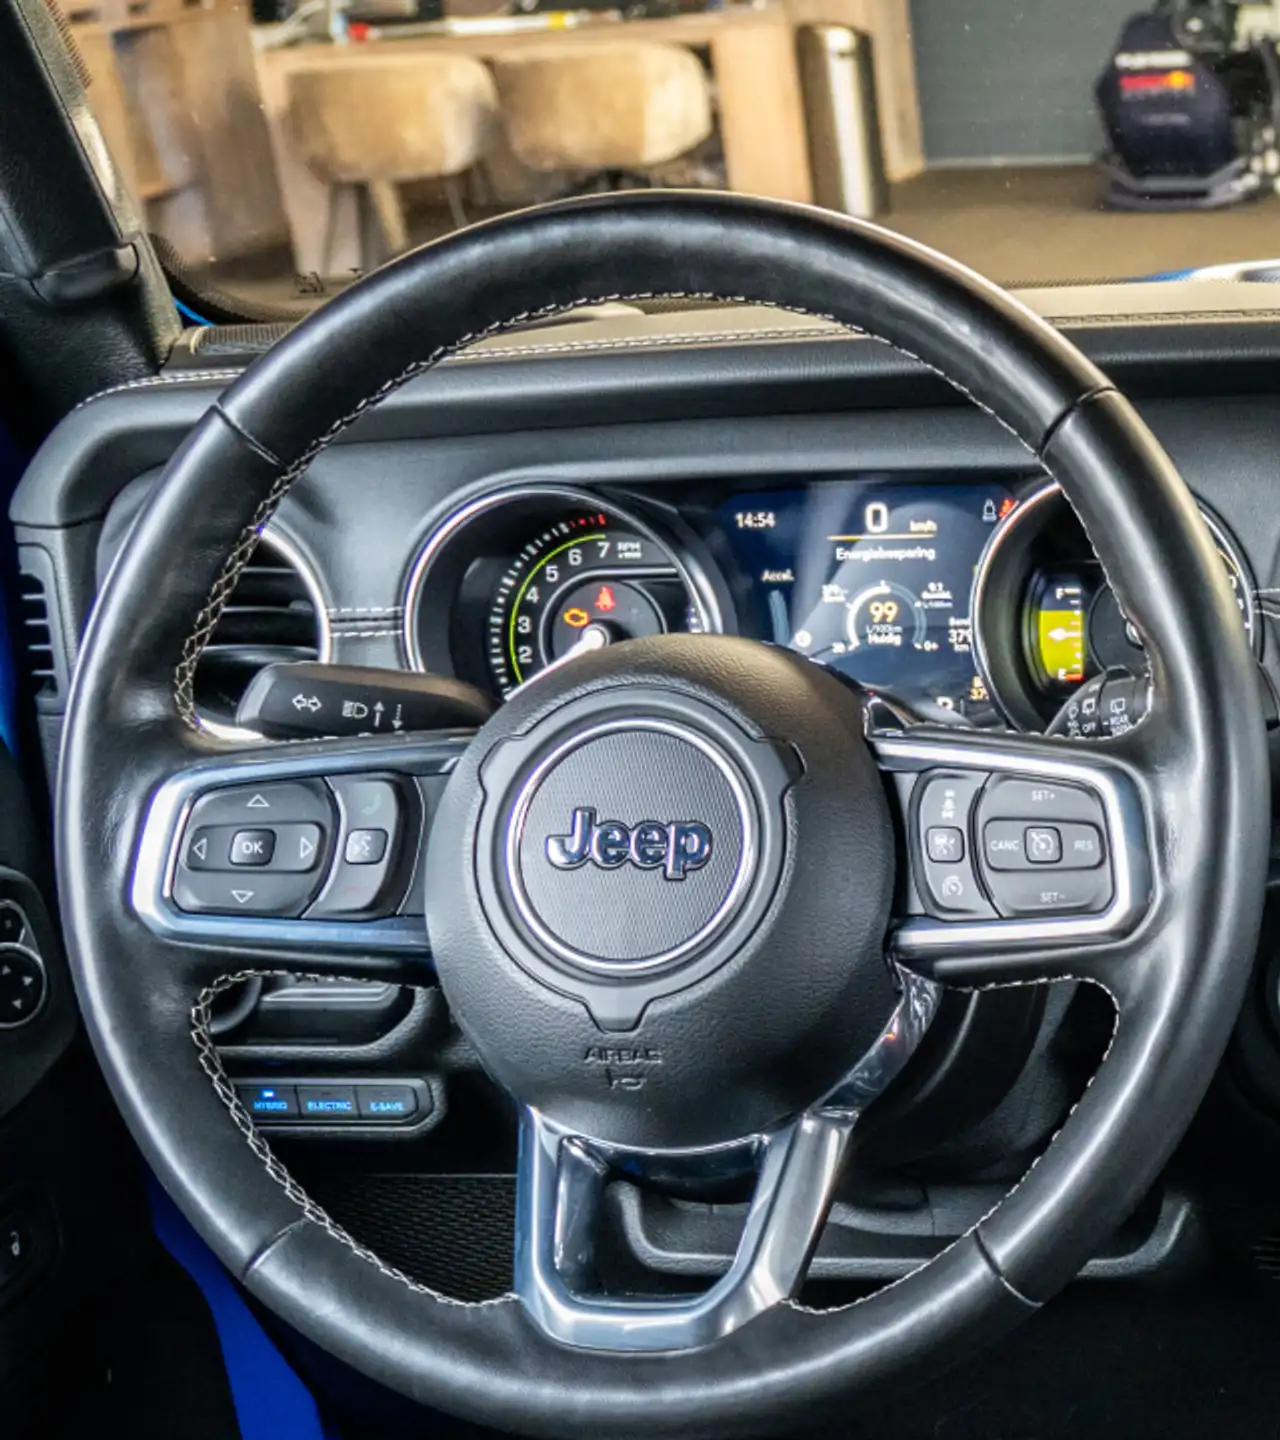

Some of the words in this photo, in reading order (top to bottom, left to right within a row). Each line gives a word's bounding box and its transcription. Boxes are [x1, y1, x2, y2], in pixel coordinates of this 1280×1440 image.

[735, 512, 776, 528] 14:54
[865, 503, 888, 533] 0
[568, 548, 583, 566] 6
[597, 541, 611, 558] 7
[545, 565, 559, 583] 5
[526, 586, 540, 603] 4
[869, 602, 898, 622] 99
[517, 616, 531, 634] 3
[518, 645, 533, 664] 2
[242, 841, 264, 854] OK
[546, 807, 713, 881] Jeep
[990, 840, 1019, 851] CANC
[1073, 840, 1094, 851] RES
[254, 1101, 288, 1110] HYBRID
[307, 1101, 352, 1111] ELECTRIC
